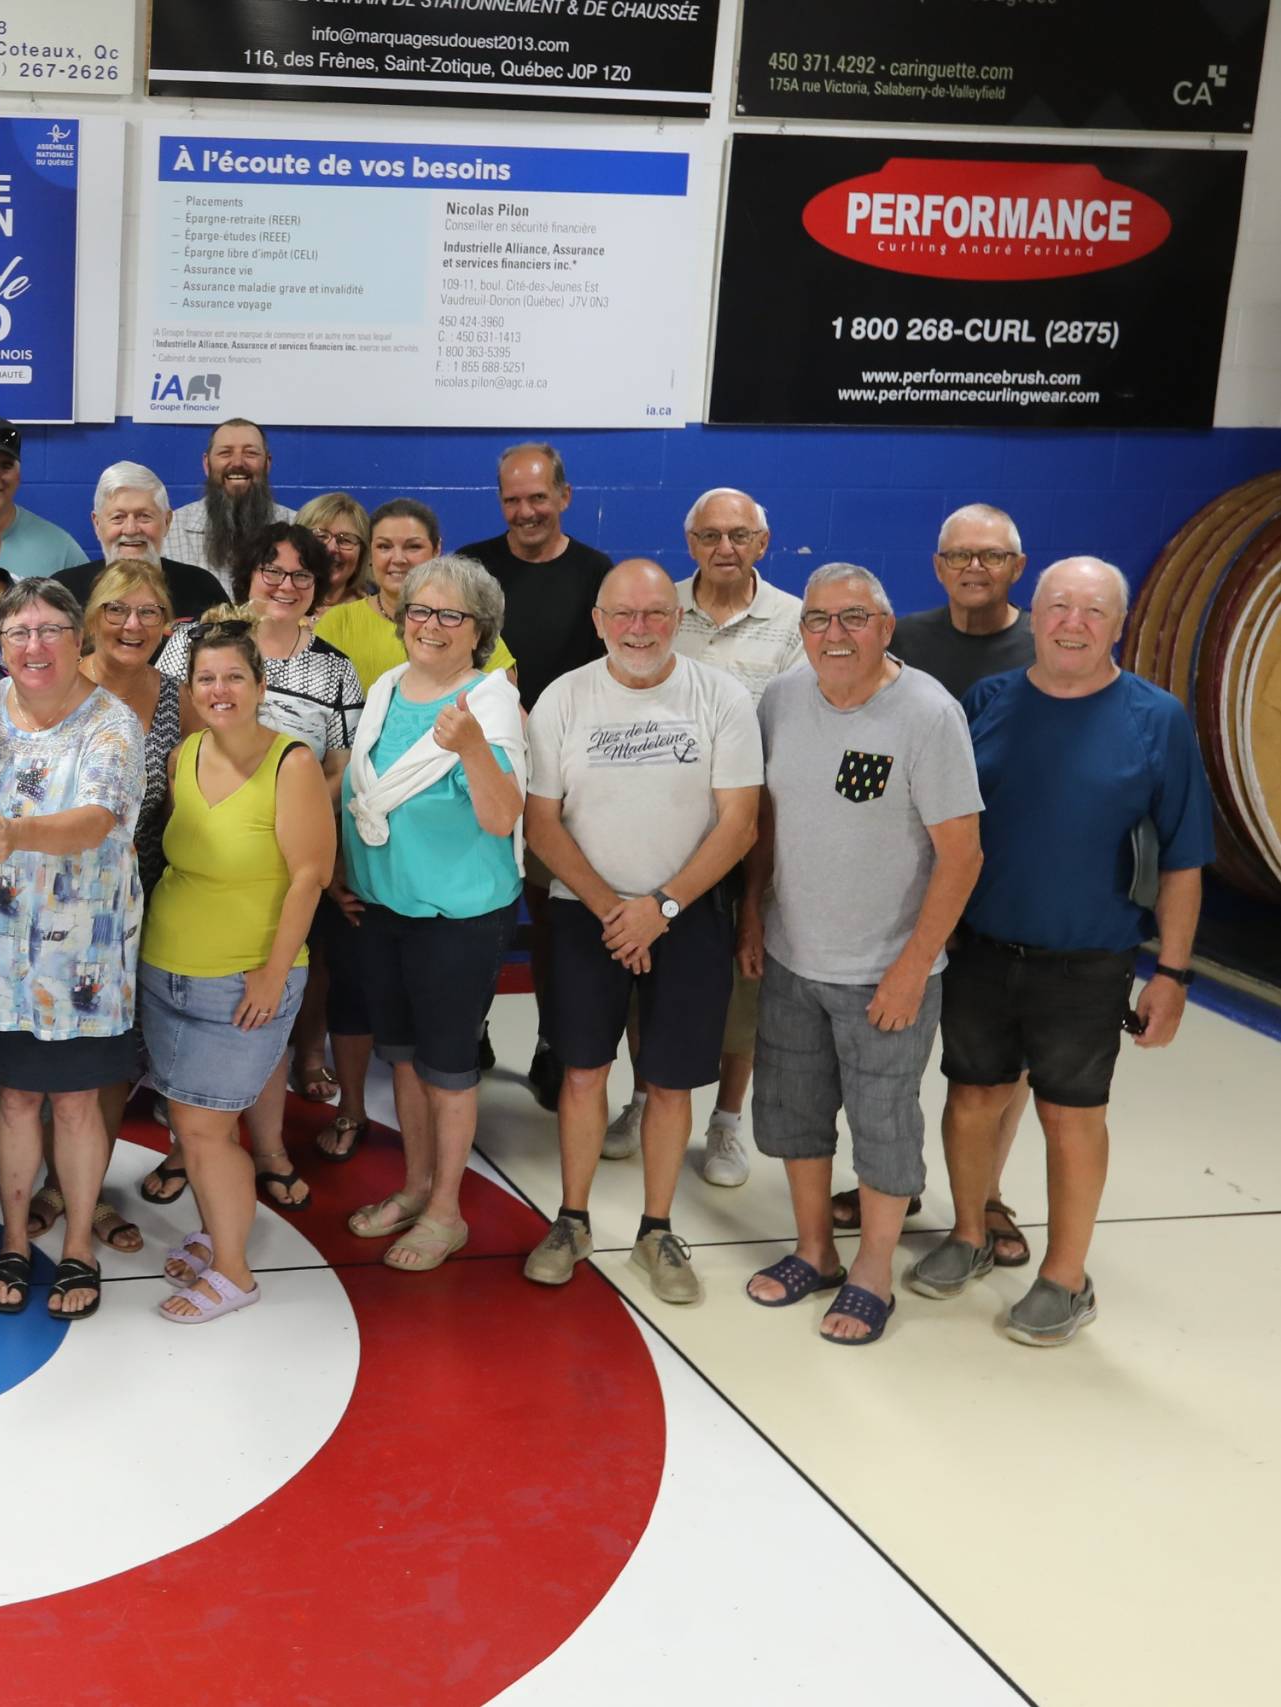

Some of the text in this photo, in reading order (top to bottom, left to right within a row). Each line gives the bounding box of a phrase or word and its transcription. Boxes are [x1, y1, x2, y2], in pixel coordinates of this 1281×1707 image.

[567, 1, 579, 16] &
[583, 1, 607, 16] DE
[611, 2, 700, 22] CHAUSSÉE
[311, 26, 570, 52] info@marquagesudouest2013.com
[94, 44, 120, 60] Qc
[19, 63, 119, 80] 267-2626
[243, 50, 632, 82] 116, des Frênes, Saint-Zotique, Québec J0P 1Z0
[769, 52, 1014, 81] 450 371.4292 caringuette.com
[770, 78, 1006, 102] 175A rue Victoria, Salaberry-de-Valleyfield
[1172, 81, 1212, 106] CA
[36, 158, 46, 166] DU
[173, 144, 195, 172] À
[319, 152, 353, 177] de
[360, 159, 405, 178] vos
[413, 154, 511, 180] besoins
[186, 196, 244, 208] Placements
[446, 202, 530, 217] Nicolas Pilon
[185, 212, 301, 226] Épargne-retraite (REER)
[846, 191, 1132, 242] PERFORMANCE
[444, 219, 493, 232] Conseiller
[496, 223, 508, 232] en
[551, 221, 597, 234] financière
[259, 232, 291, 243] (REEE)
[184, 246, 224, 260] Épargne
[227, 248, 249, 259] libre
[444, 241, 606, 256] Industrielle Alliance, Assurance
[878, 241, 1095, 258] Curling André Ferland
[184, 264, 254, 276] Assurance vie
[442, 258, 452, 268] et
[455, 258, 499, 269] services
[501, 258, 552, 270] financiers
[183, 281, 236, 293] Assurance
[238, 283, 276, 294] maladie
[279, 286, 307, 296] grave
[309, 286, 320, 295] et
[506, 280, 583, 293] Cité-des-Jeunes
[584, 281, 600, 292] Est
[182, 298, 273, 312] Assurance voyage
[438, 316, 505, 329] 450 424-3960
[456, 332, 521, 344] 450 631-1413
[832, 317, 1120, 349] 1 800 268-CURL (2875)
[446, 346, 465, 358] 800
[466, 347, 511, 358] 363-5395
[461, 362, 480, 373] 855
[482, 362, 526, 374] 688-5251
[434, 376, 548, 390] nicolas.pilon@agc.ia.ca
[861, 368, 1081, 389] www.performancebrush.com
[837, 387, 1100, 406] www.performancecurlingwear.com
[150, 403, 220, 413] Groupe financier
[646, 404, 672, 416] ia.ca
[624, 724, 642, 739] de
[645, 720, 658, 735] la
[604, 732, 688, 760] Madeleine
